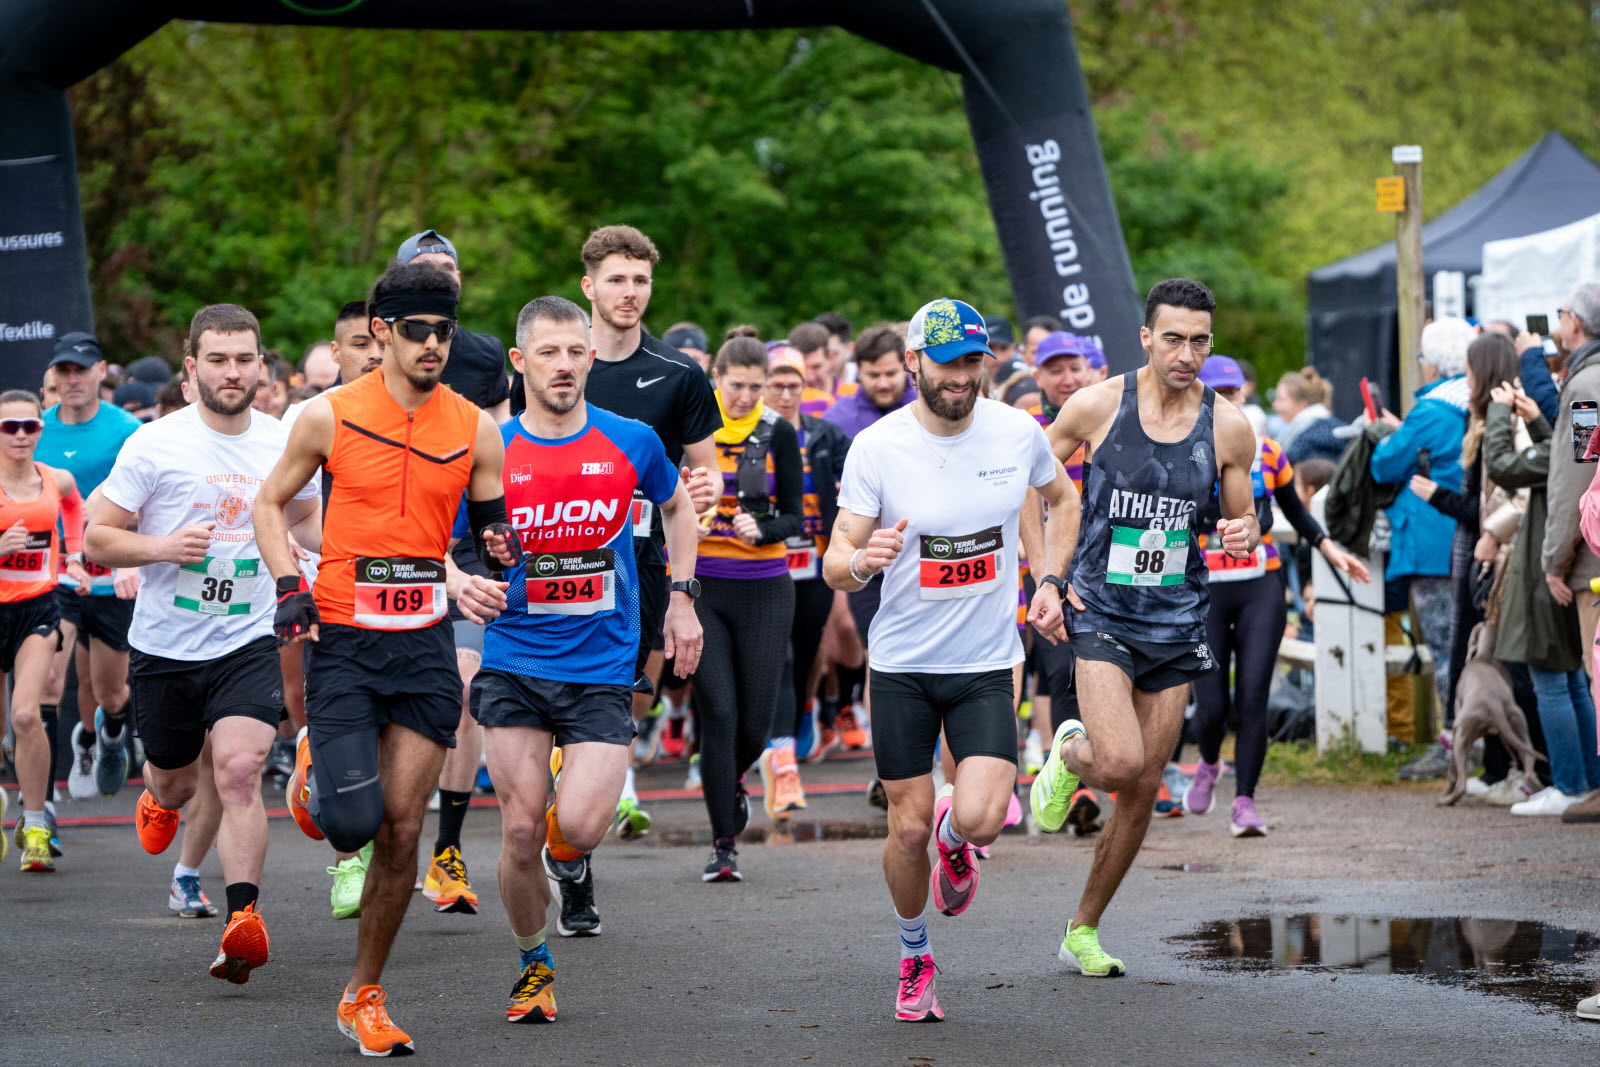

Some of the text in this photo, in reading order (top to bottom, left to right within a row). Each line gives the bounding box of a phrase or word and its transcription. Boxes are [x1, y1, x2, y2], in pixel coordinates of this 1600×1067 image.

[1025, 139, 1096, 329] de running
[0, 320, 56, 341] Textile
[206, 474, 264, 487] UNIVERSIT
[510, 473, 532, 484] Dijon
[1109, 488, 1196, 518] ATHLETIC
[511, 499, 618, 530] DIJON
[1149, 513, 1189, 531] GYM
[521, 525, 606, 543] Triathlon
[932, 544, 950, 552] TDR
[2, 554, 38, 569] 266
[539, 562, 555, 570] TDR
[560, 557, 582, 565] TERRE
[1134, 550, 1165, 573] 98
[370, 567, 387, 576] TDR
[939, 560, 987, 584] 298
[201, 577, 234, 603] 36
[545, 579, 595, 600] 294
[376, 589, 424, 612] 169
